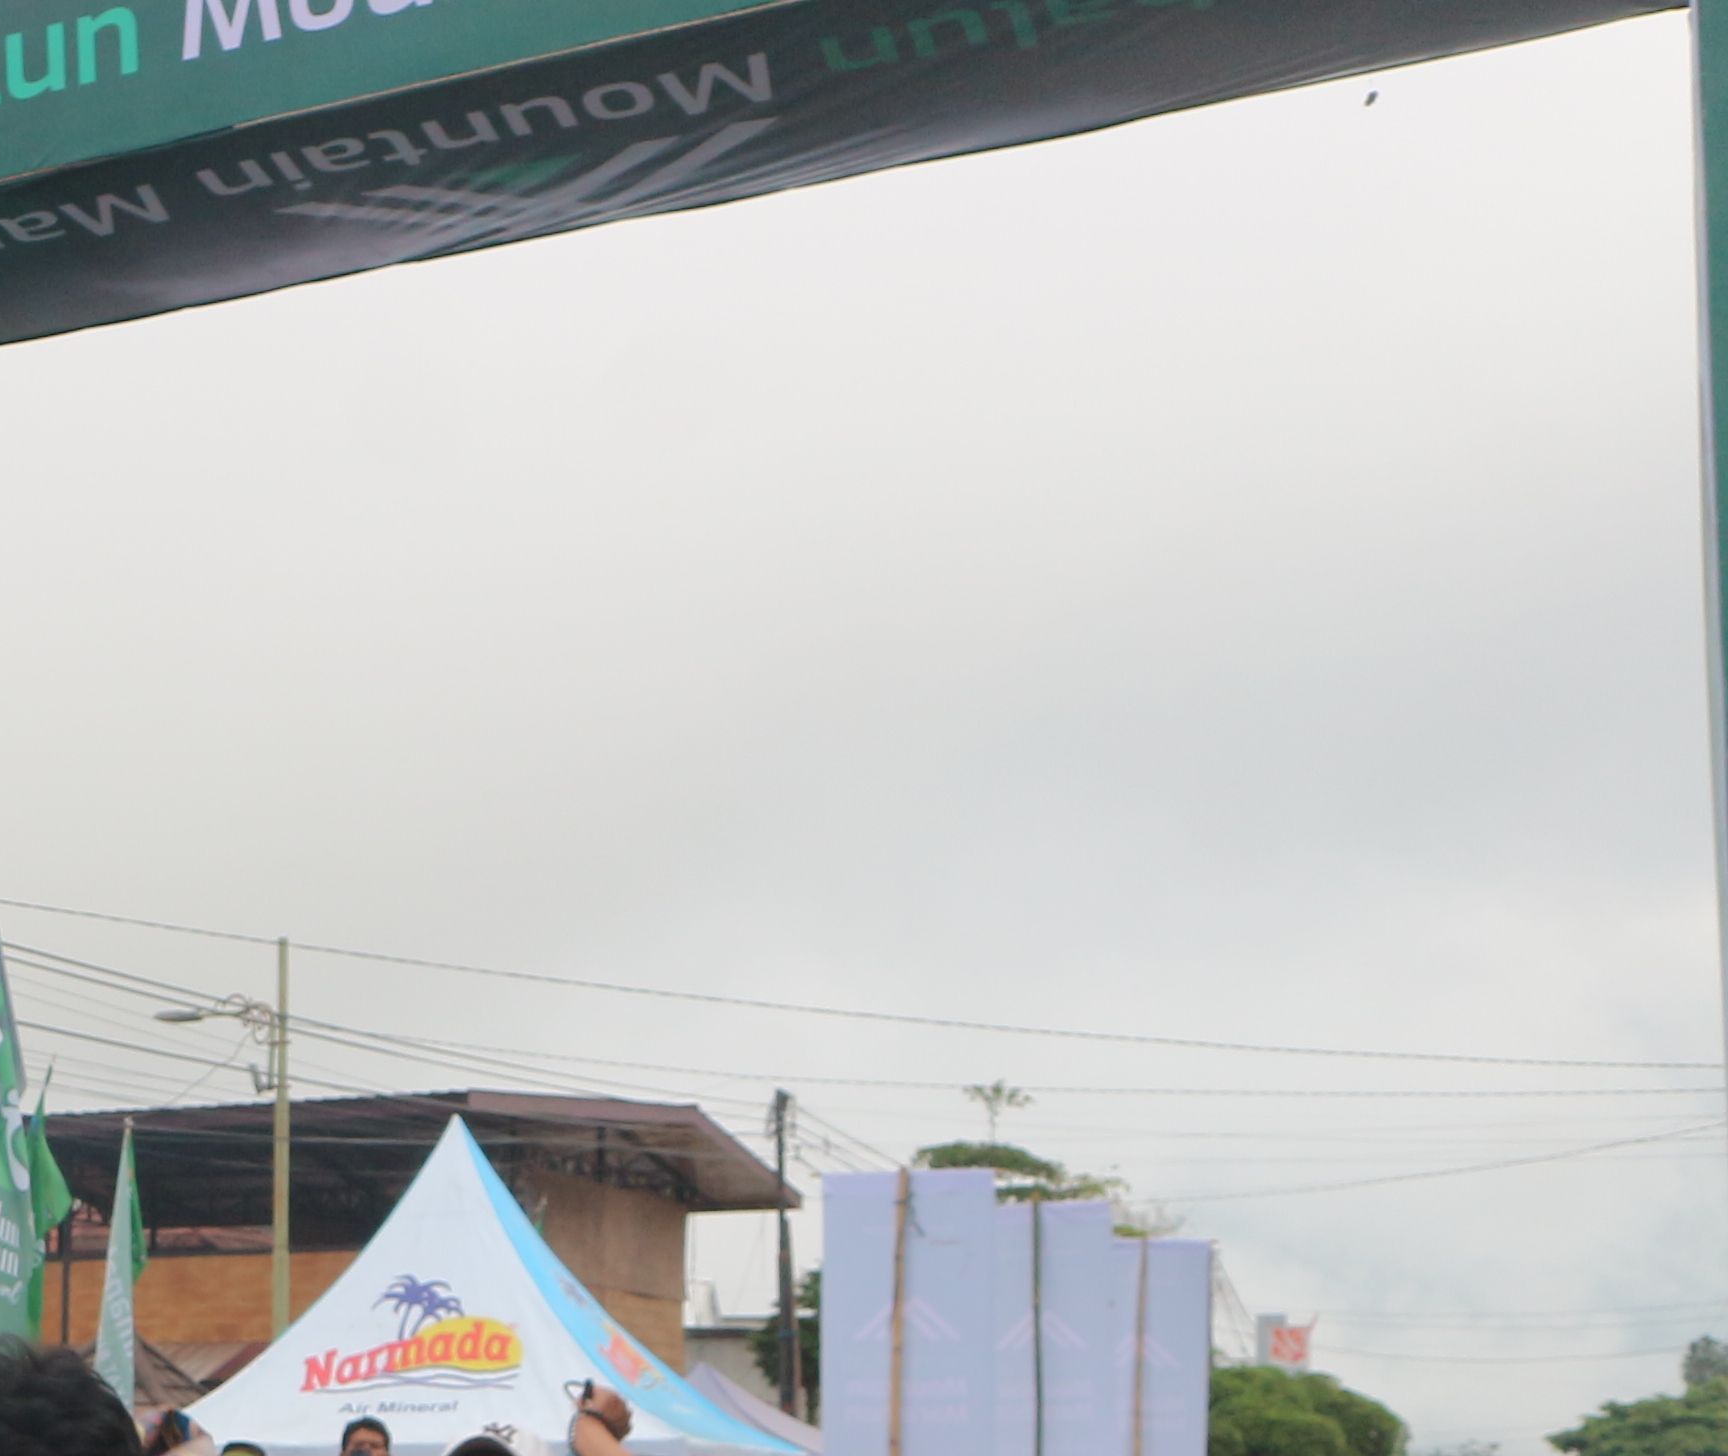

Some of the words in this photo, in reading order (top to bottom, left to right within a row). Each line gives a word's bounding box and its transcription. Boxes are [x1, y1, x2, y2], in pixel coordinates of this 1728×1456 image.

[195, 51, 774, 198] Mountain
[300, 1320, 512, 1393] Narmada
[338, 1401, 369, 1414] Air
[376, 1400, 459, 1413] Mineral
